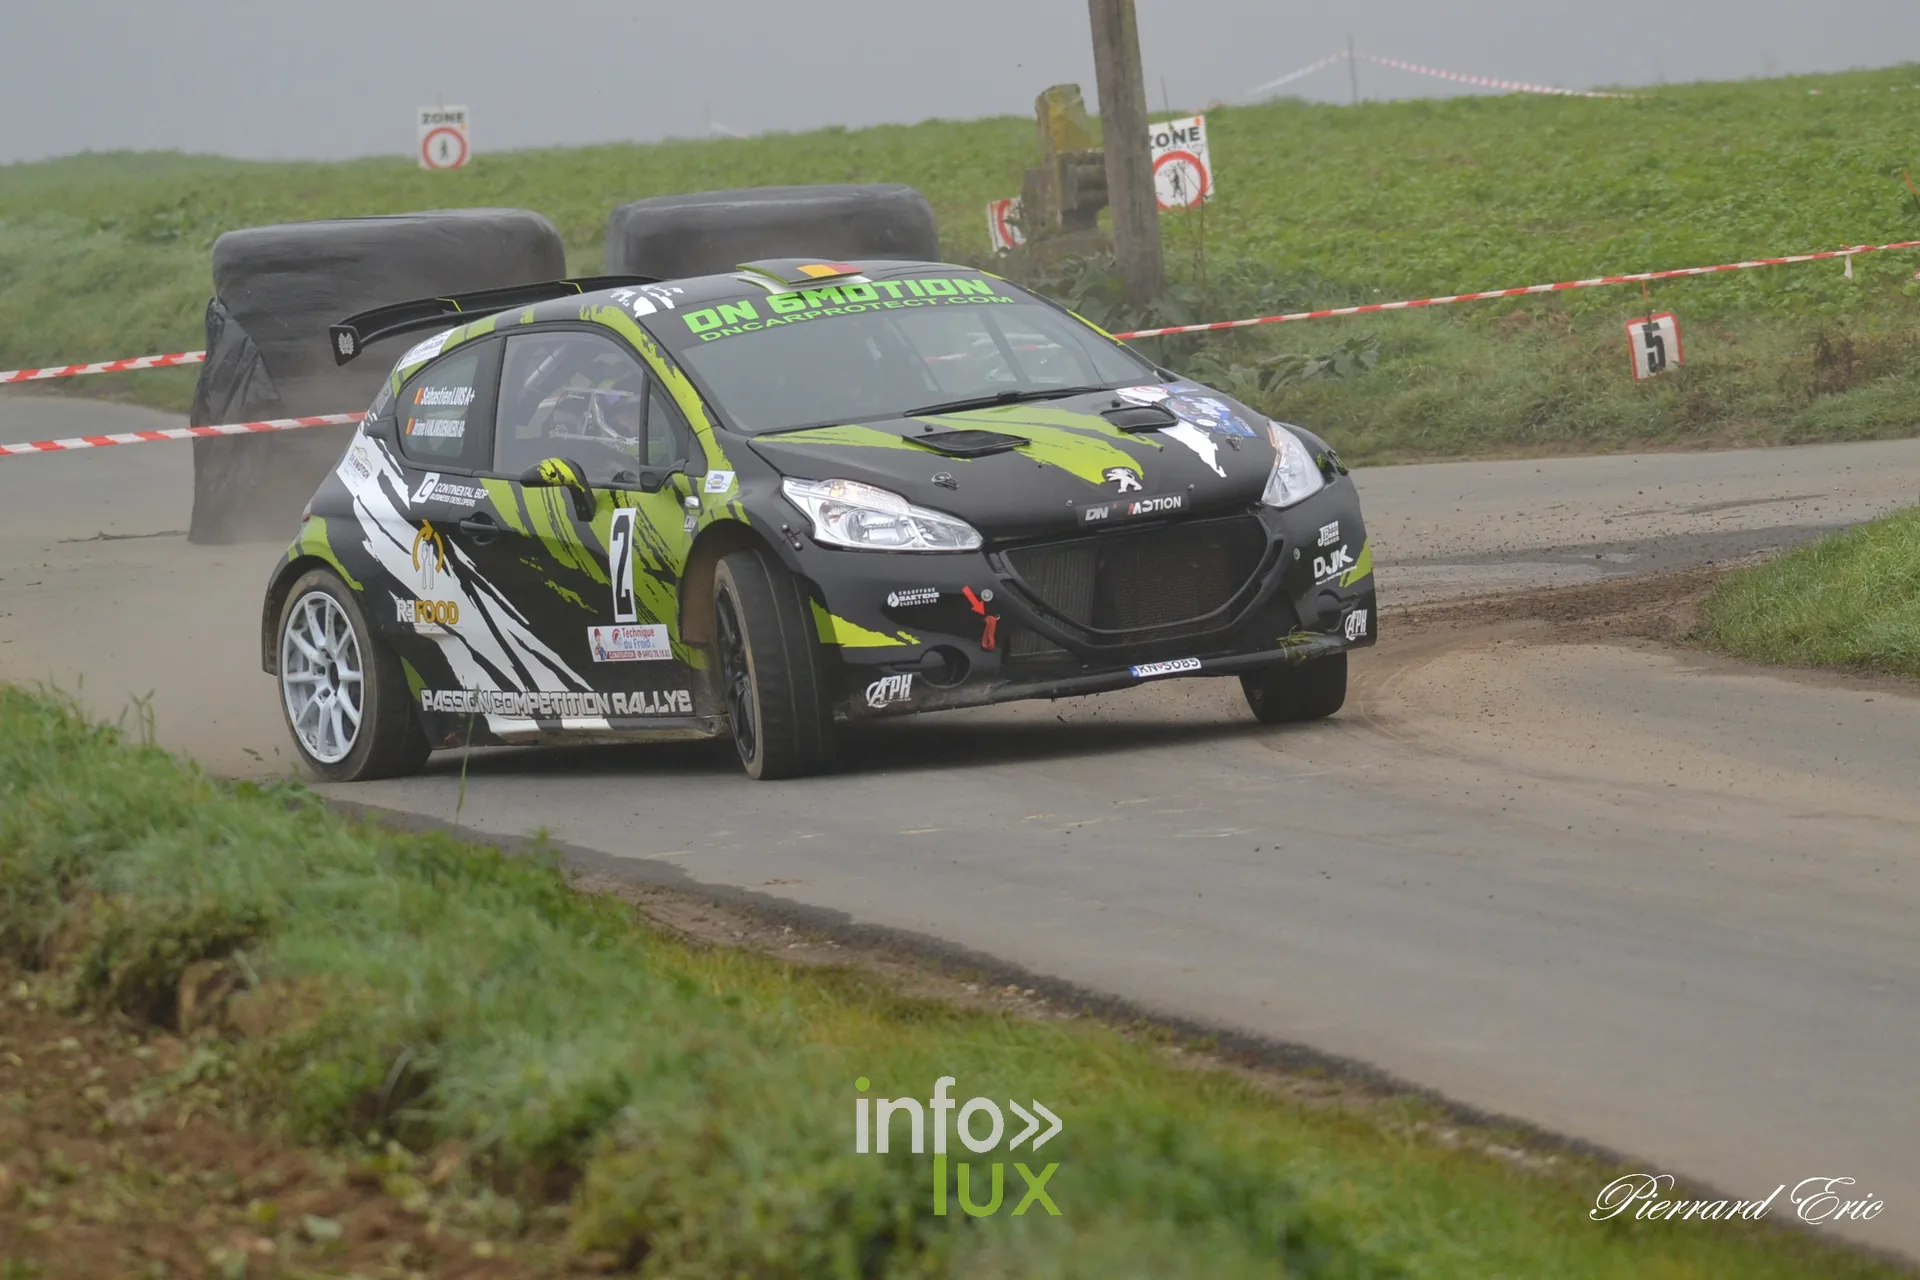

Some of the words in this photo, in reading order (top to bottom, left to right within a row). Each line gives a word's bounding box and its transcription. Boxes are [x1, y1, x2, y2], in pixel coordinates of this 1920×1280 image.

[421, 112, 465, 125] ZONE
[682, 300, 759, 333] DN
[1641, 322, 1666, 373] 5
[429, 493, 451, 502] BUSINESS
[435, 483, 475, 498] CONTINENTAL
[1085, 507, 1109, 521] DN
[612, 515, 633, 615] 2
[1313, 544, 1354, 579] DJK
[898, 587, 935, 596] CHAUFFAGE
[899, 592, 940, 602] BAETENS
[622, 627, 655, 641] Technique
[624, 639, 632, 648] du
[634, 639, 651, 648] Froid
[421, 690, 492, 714] PASSION
[490, 691, 611, 715] COMPETITION
[612, 690, 693, 714] RALLYE
